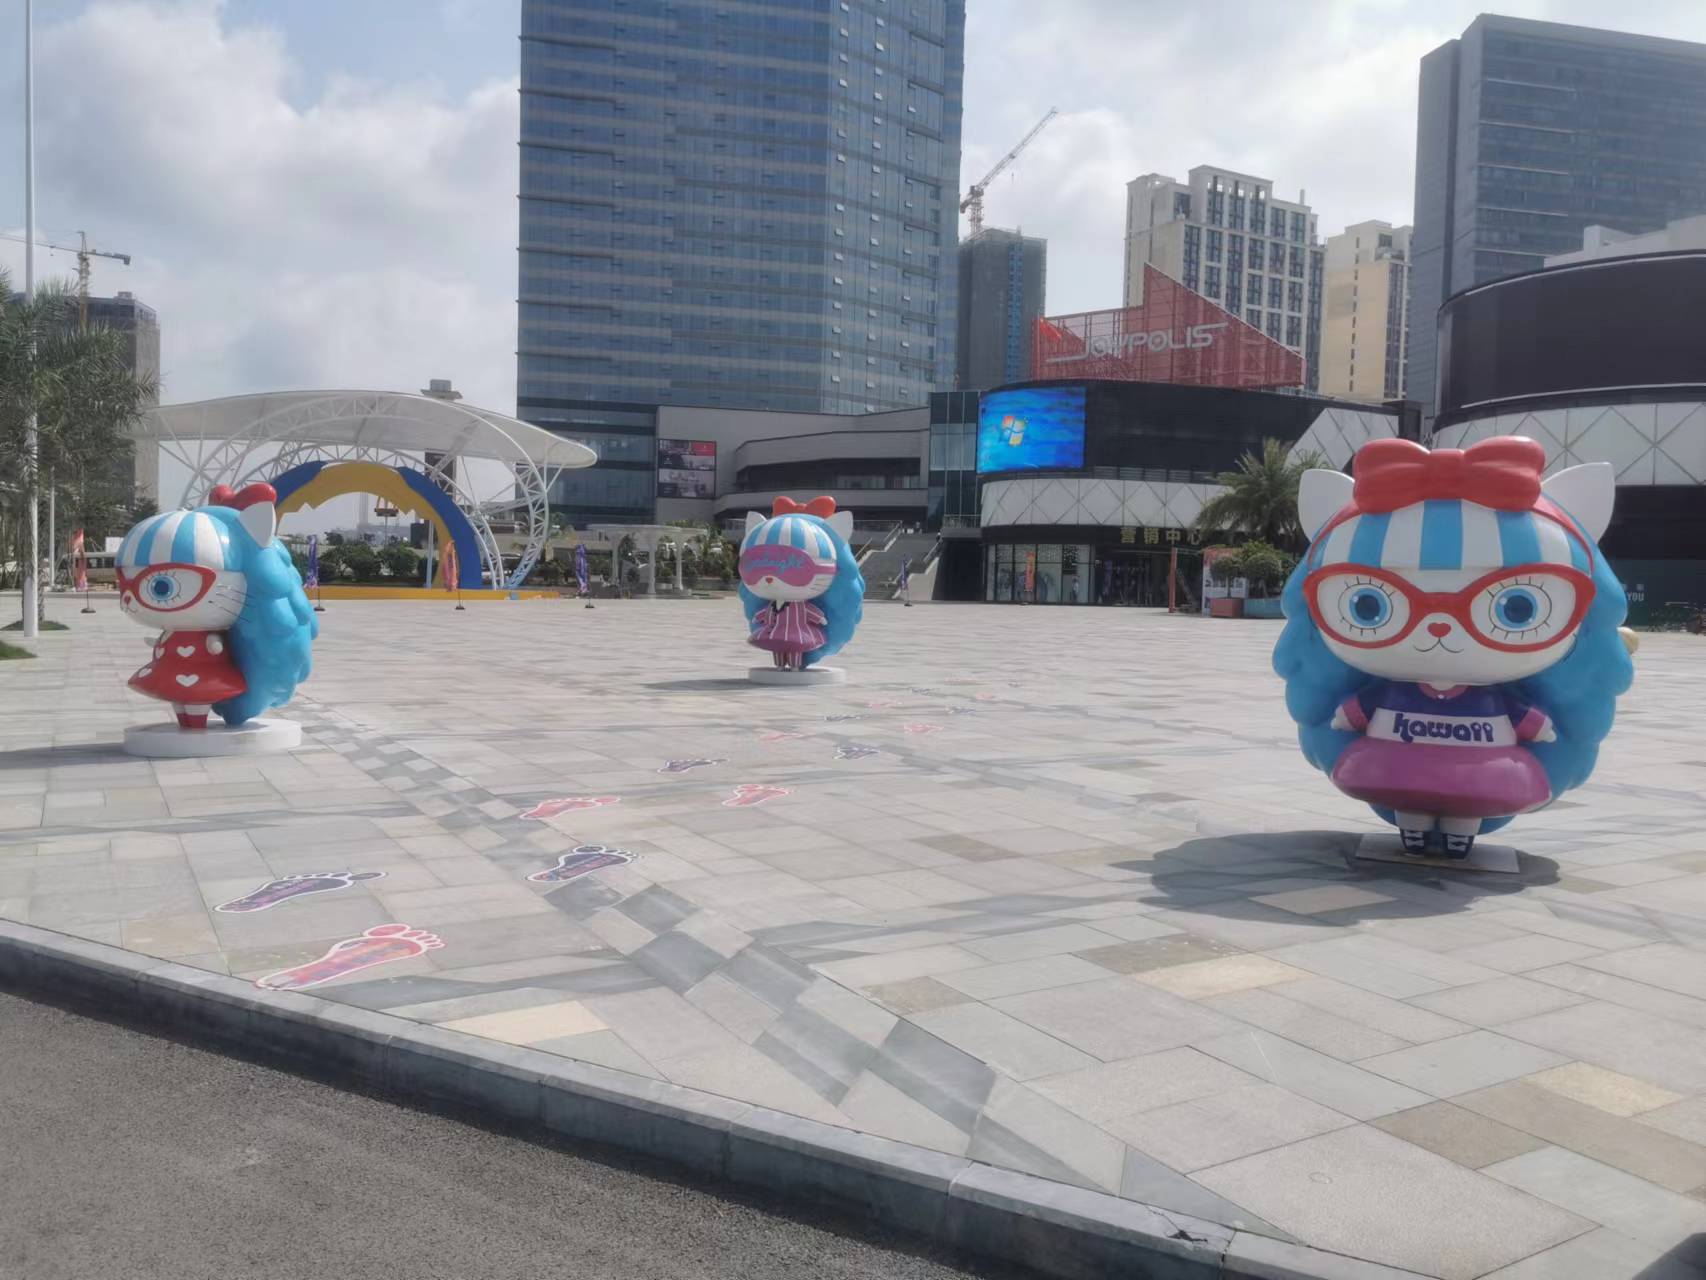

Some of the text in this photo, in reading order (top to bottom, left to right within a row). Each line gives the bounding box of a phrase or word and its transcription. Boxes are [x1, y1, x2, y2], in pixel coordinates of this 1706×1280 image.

[1120, 527, 1202, 545] 营销中心
[1393, 712, 1494, 743] kawaii
